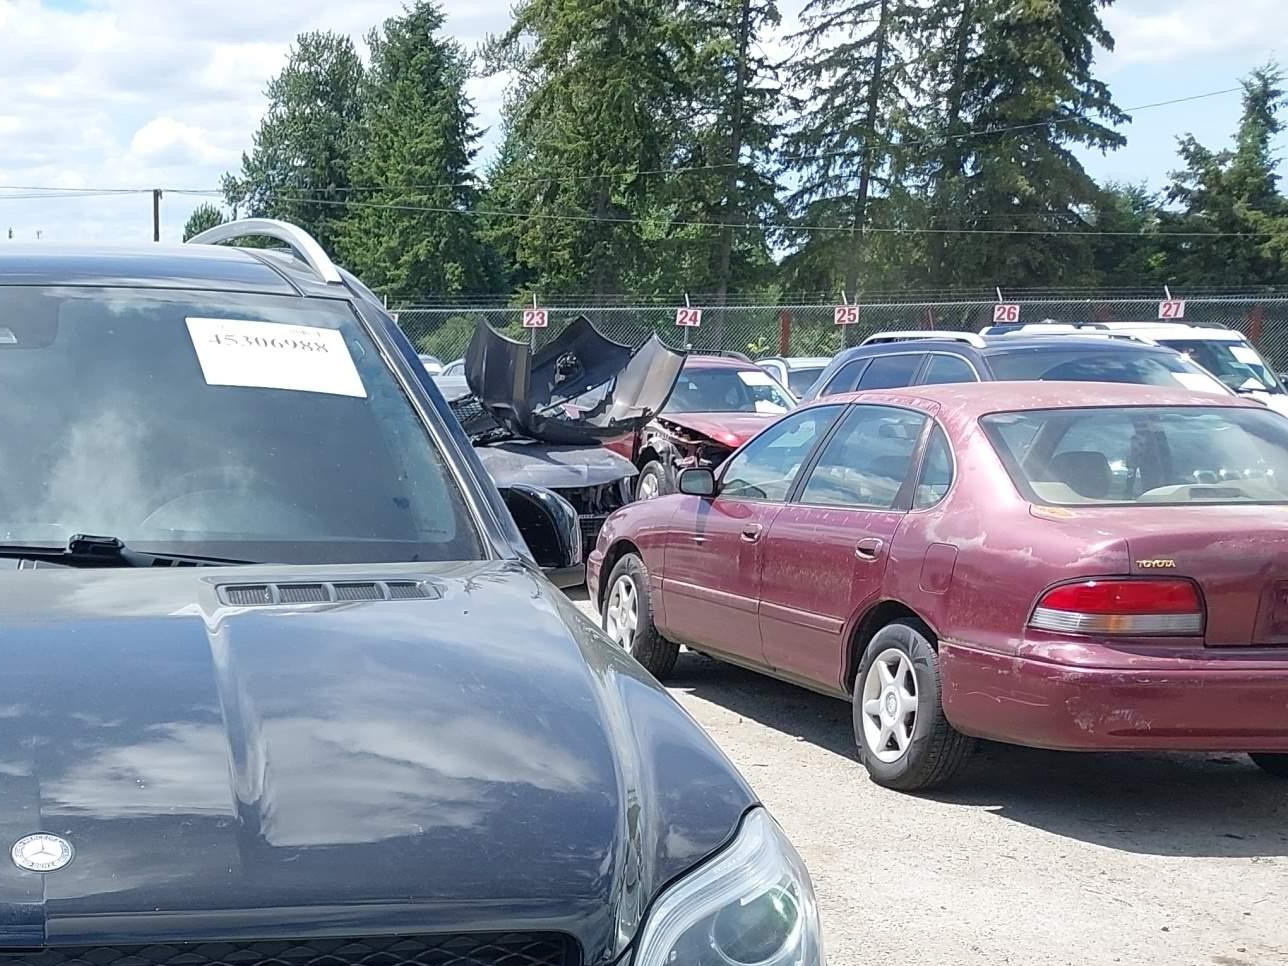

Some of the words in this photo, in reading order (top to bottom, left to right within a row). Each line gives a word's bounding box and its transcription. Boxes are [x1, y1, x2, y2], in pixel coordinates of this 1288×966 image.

[679, 309, 698, 325] 24
[837, 307, 857, 323] 25
[996, 305, 1017, 321] 26
[1162, 302, 1182, 317] 27
[525, 311, 546, 326] 23
[1135, 559, 1177, 568] TOYOTA
